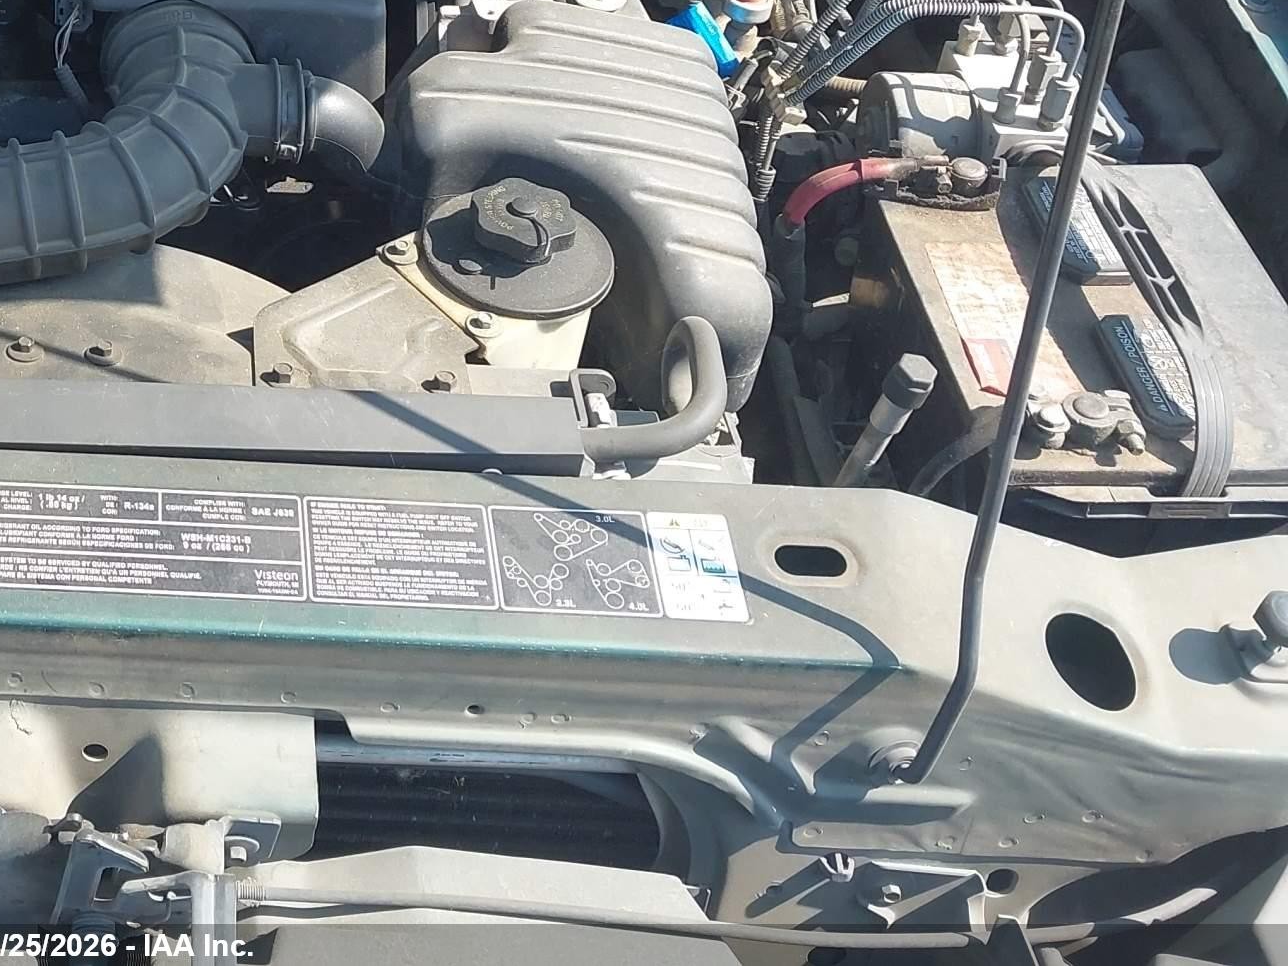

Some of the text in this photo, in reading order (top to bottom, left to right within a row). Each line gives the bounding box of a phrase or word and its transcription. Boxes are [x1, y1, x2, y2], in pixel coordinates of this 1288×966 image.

[1114, 326, 1139, 358] POISON
[1135, 366, 1164, 403] DANGER
[123, 502, 155, 511] R-134a
[251, 507, 271, 516] SAE
[595, 515, 616, 523] 3.0L
[255, 569, 299, 580] Visteon
[628, 602, 650, 611] 4.0L
